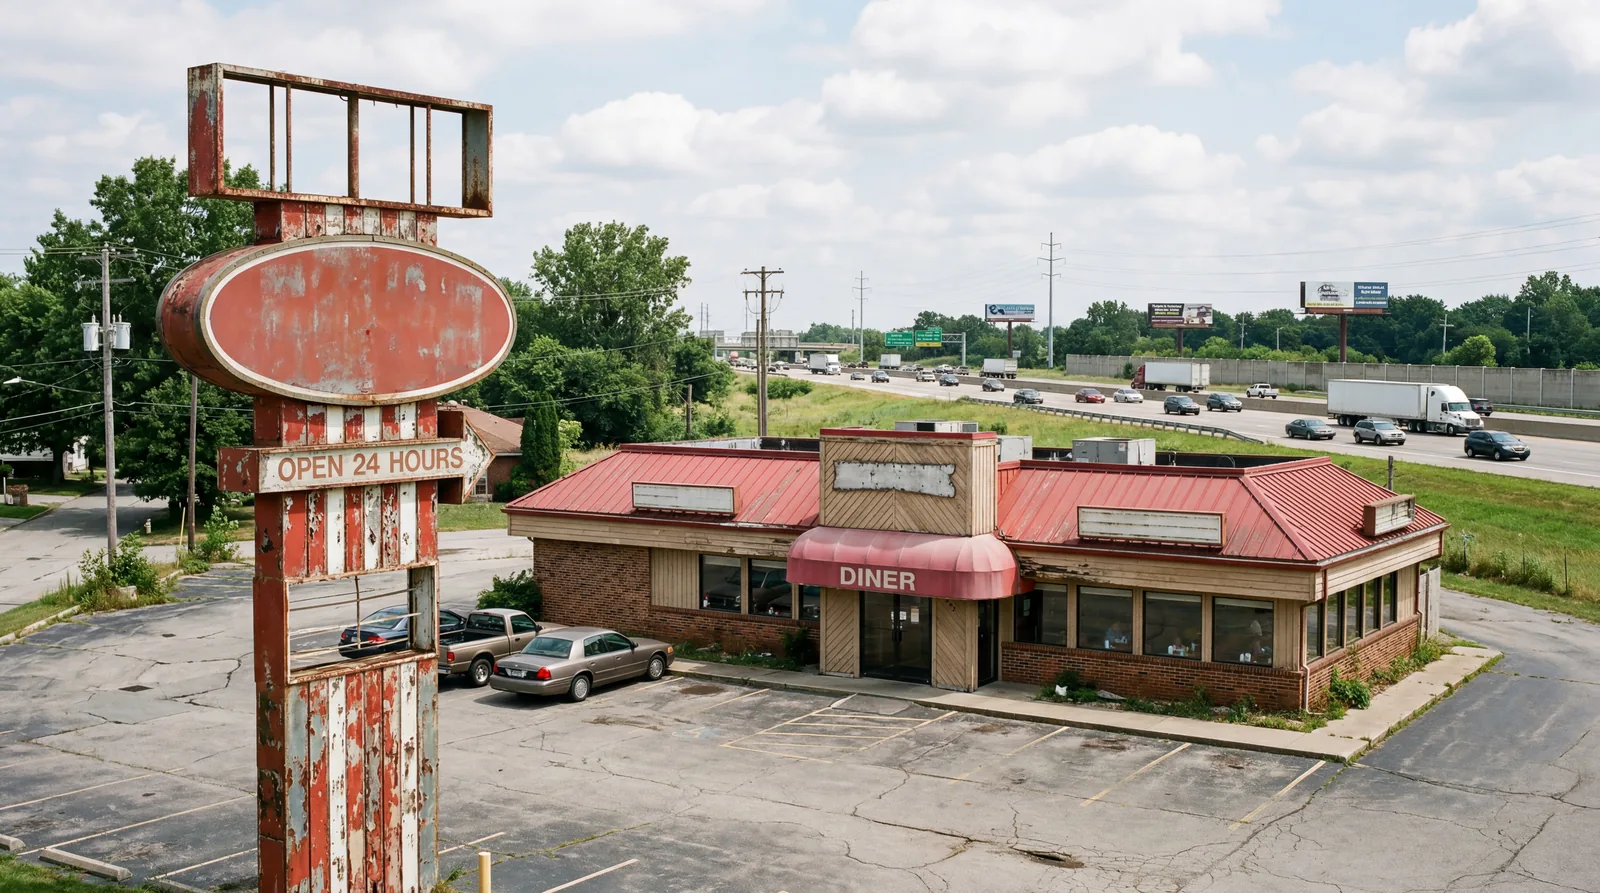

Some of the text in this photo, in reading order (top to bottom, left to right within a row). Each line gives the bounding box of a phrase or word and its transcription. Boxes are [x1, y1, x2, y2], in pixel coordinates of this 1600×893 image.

[278, 447, 463, 482] OPEN 24 HOURS
[840, 566, 916, 591] DINER
